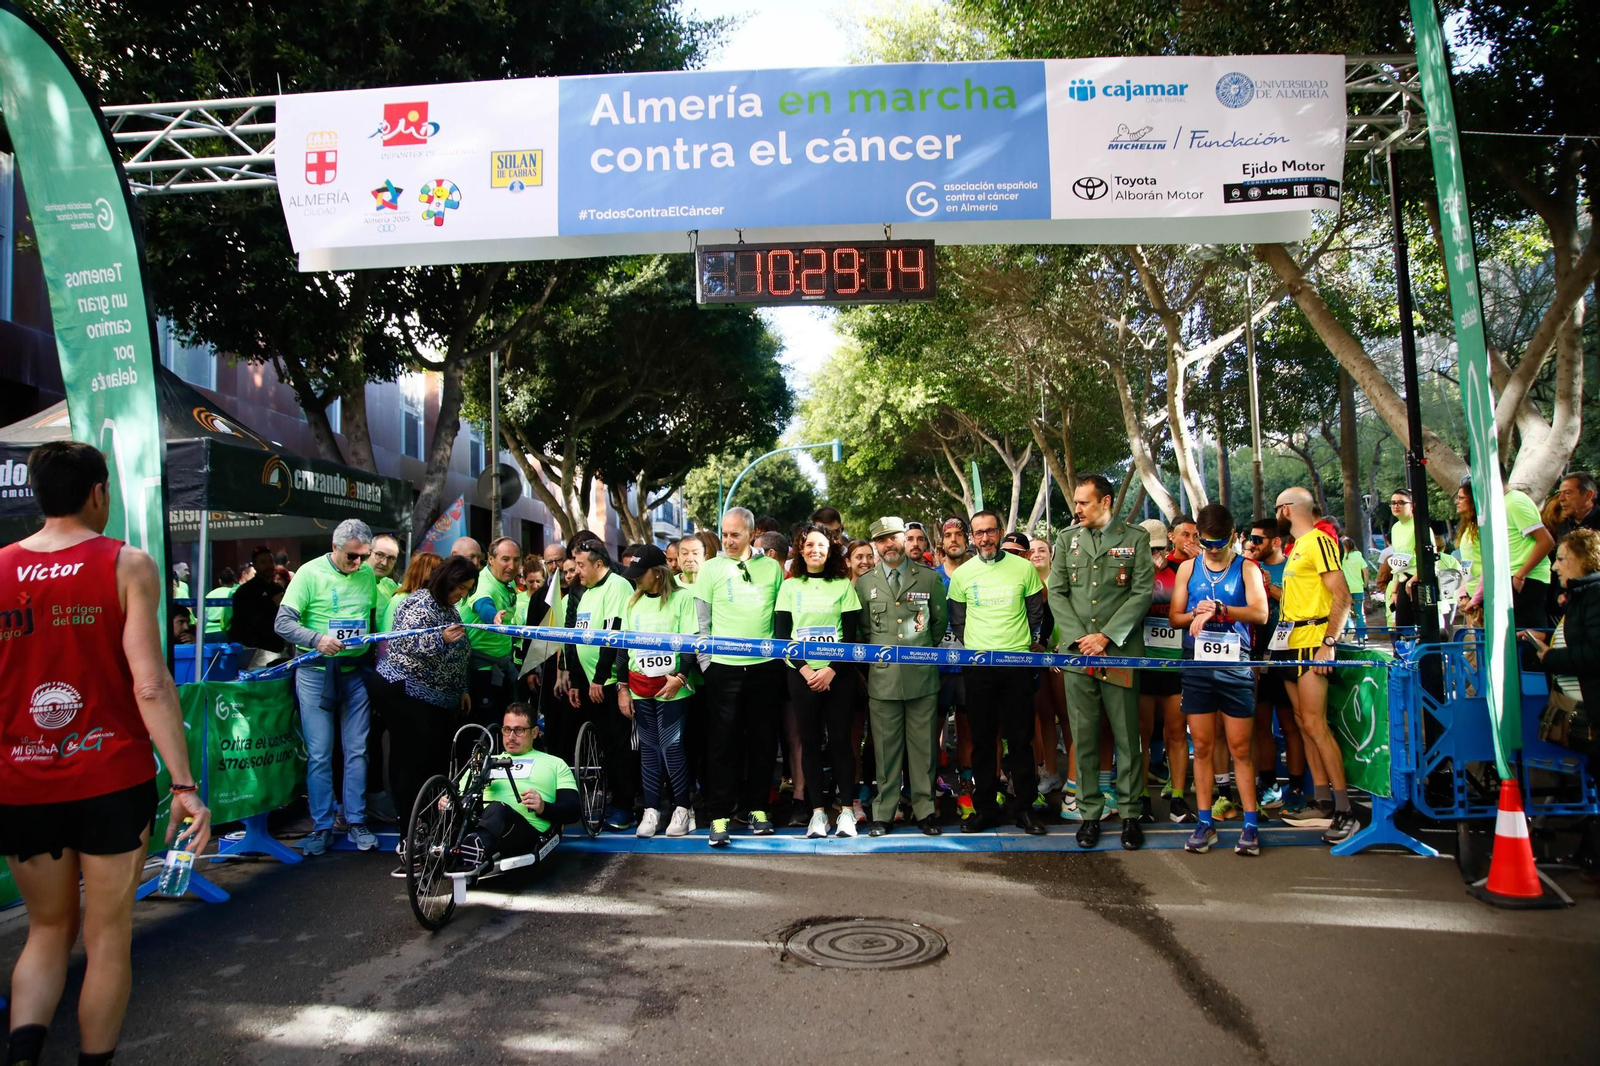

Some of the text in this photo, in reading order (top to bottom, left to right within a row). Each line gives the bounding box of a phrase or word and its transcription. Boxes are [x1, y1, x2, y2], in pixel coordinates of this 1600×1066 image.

[1255, 79, 1329, 89] UNIVERSIDAD
[1102, 79, 1188, 102] cajamar
[1256, 89, 1272, 99] DE
[589, 78, 1017, 126] Almería en marcha
[1108, 129, 1290, 150] MICHELIN Fundación
[590, 128, 961, 174] contra el cáncer
[509, 167, 537, 178] CABRAS
[1242, 160, 1325, 178] Ejido Motor
[944, 181, 1038, 192] asociación española
[1115, 176, 1157, 187] Toyota
[945, 191, 1019, 202] contra el cáncer
[1115, 188, 1204, 200] Alborán Motor
[1267, 187, 1288, 196] Jeep
[1293, 184, 1309, 197] FIAT
[288, 189, 350, 208] ALMERÍA
[578, 205, 724, 221] #TodosContraElCáncer
[946, 203, 998, 212] en Almería
[16, 562, 85, 582] Víctor
[52, 604, 103, 616] El origen
[52, 617, 70, 627] del
[336, 628, 360, 640] 871
[1150, 627, 1176, 639] 500
[1203, 641, 1230, 655] 691
[638, 655, 673, 668] 1509
